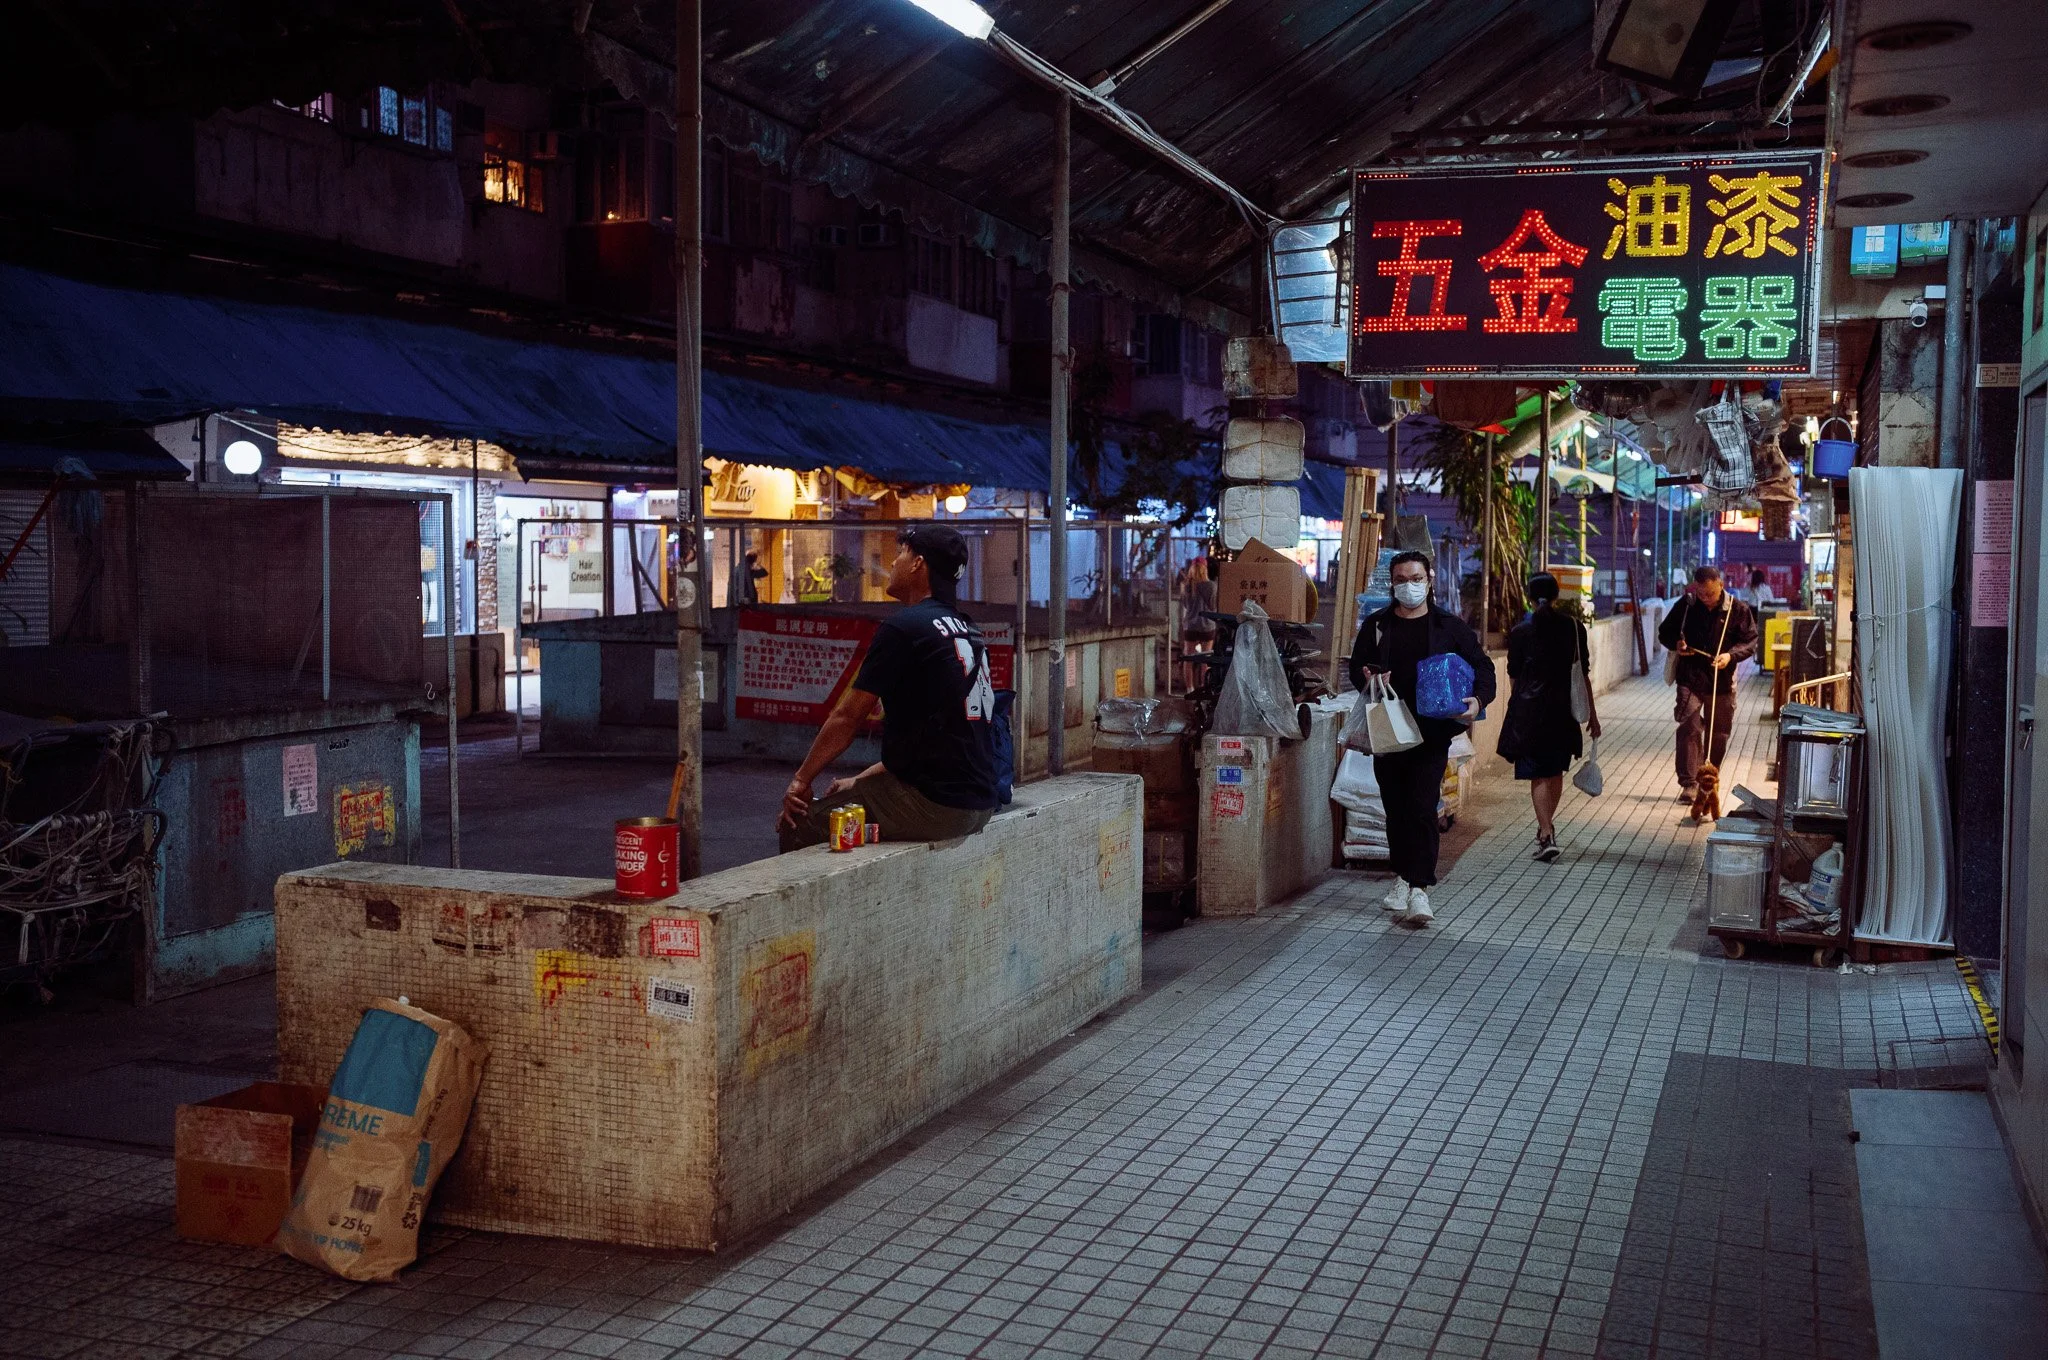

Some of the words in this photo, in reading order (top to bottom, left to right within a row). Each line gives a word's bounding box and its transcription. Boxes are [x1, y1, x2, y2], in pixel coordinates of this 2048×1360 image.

[1602, 171, 1802, 261] 油漆
[1363, 209, 1589, 333] 五金
[1597, 276, 1797, 361] 電器
[571, 571, 602, 582] Creation
[578, 559, 594, 570] Hair
